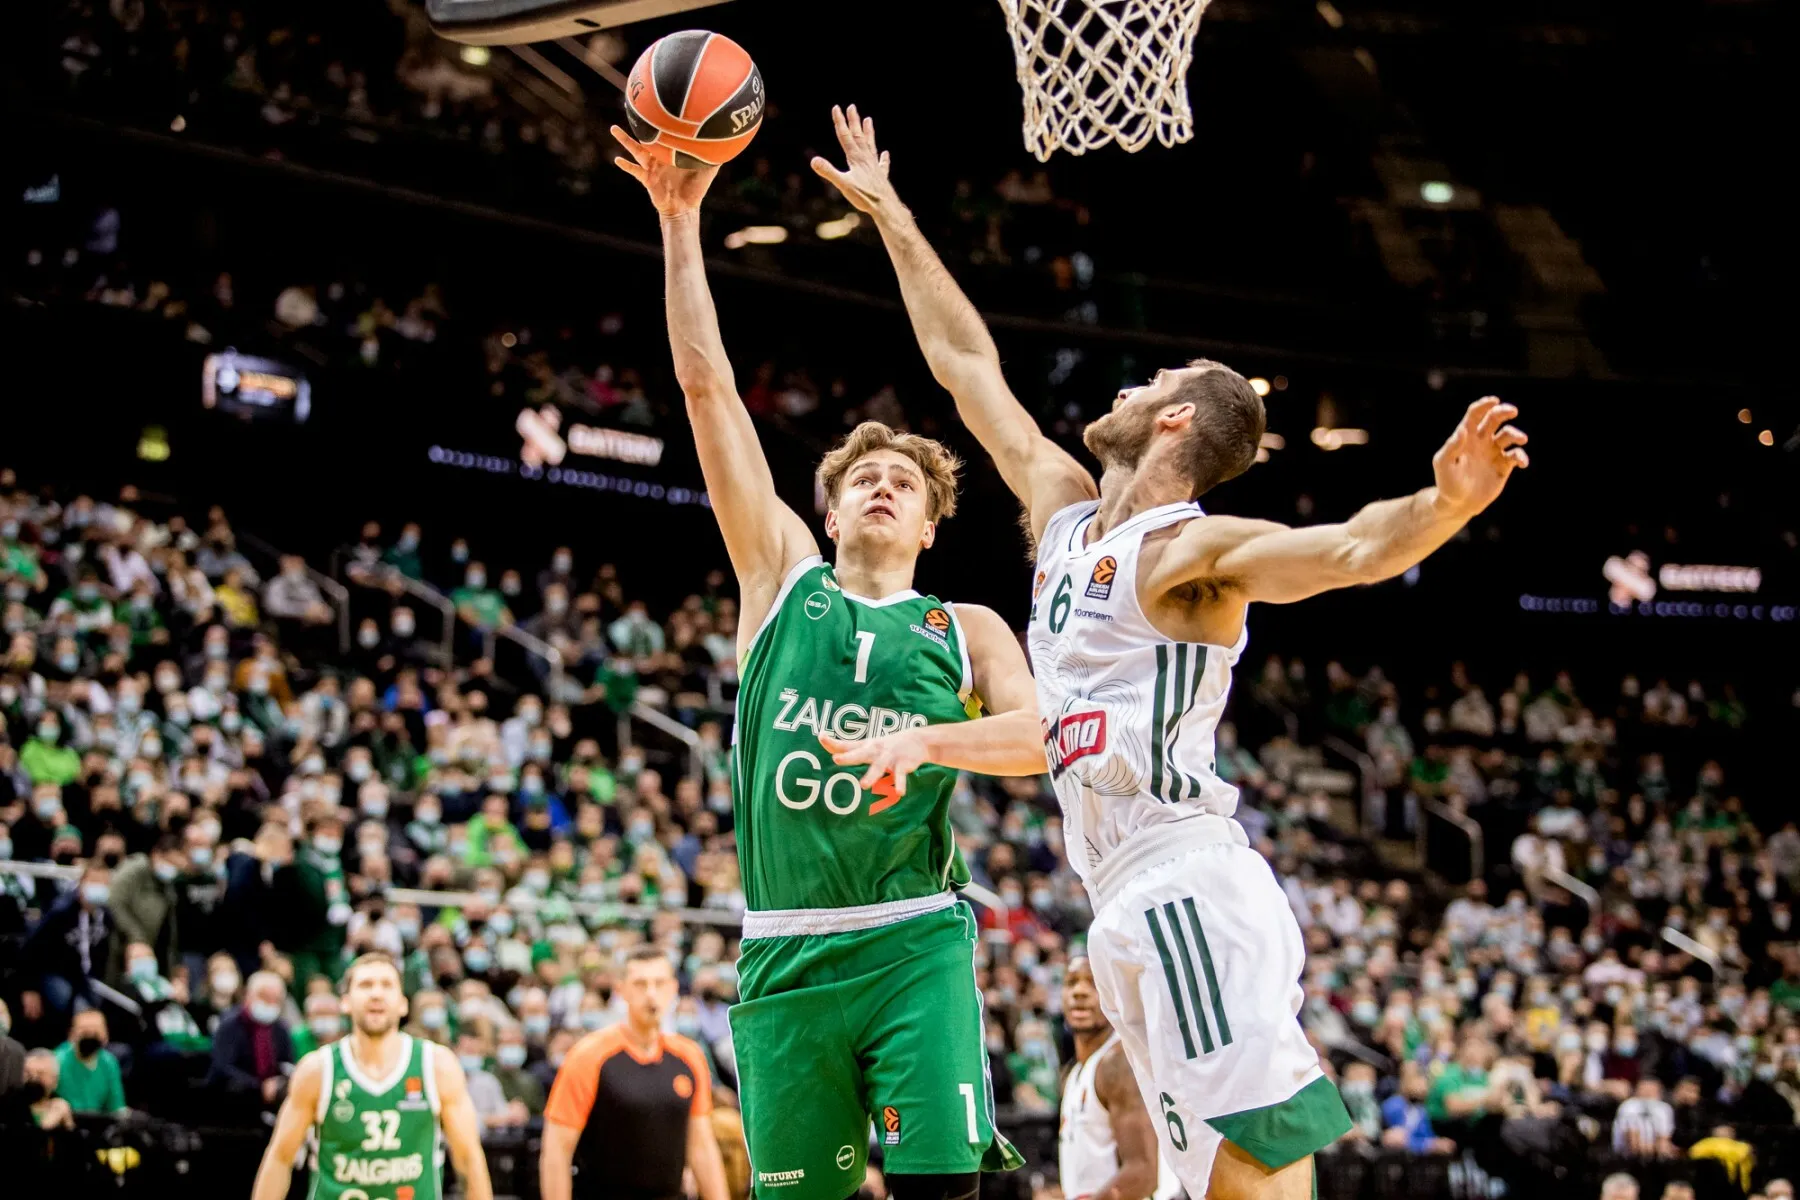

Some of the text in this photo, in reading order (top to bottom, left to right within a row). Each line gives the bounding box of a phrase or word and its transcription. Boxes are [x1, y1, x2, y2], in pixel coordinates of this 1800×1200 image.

[1049, 573, 1073, 634] 6
[855, 631, 876, 683] 1
[360, 1110, 402, 1151] 32
[958, 1083, 980, 1143] 1
[1159, 1091, 1188, 1152] 6
